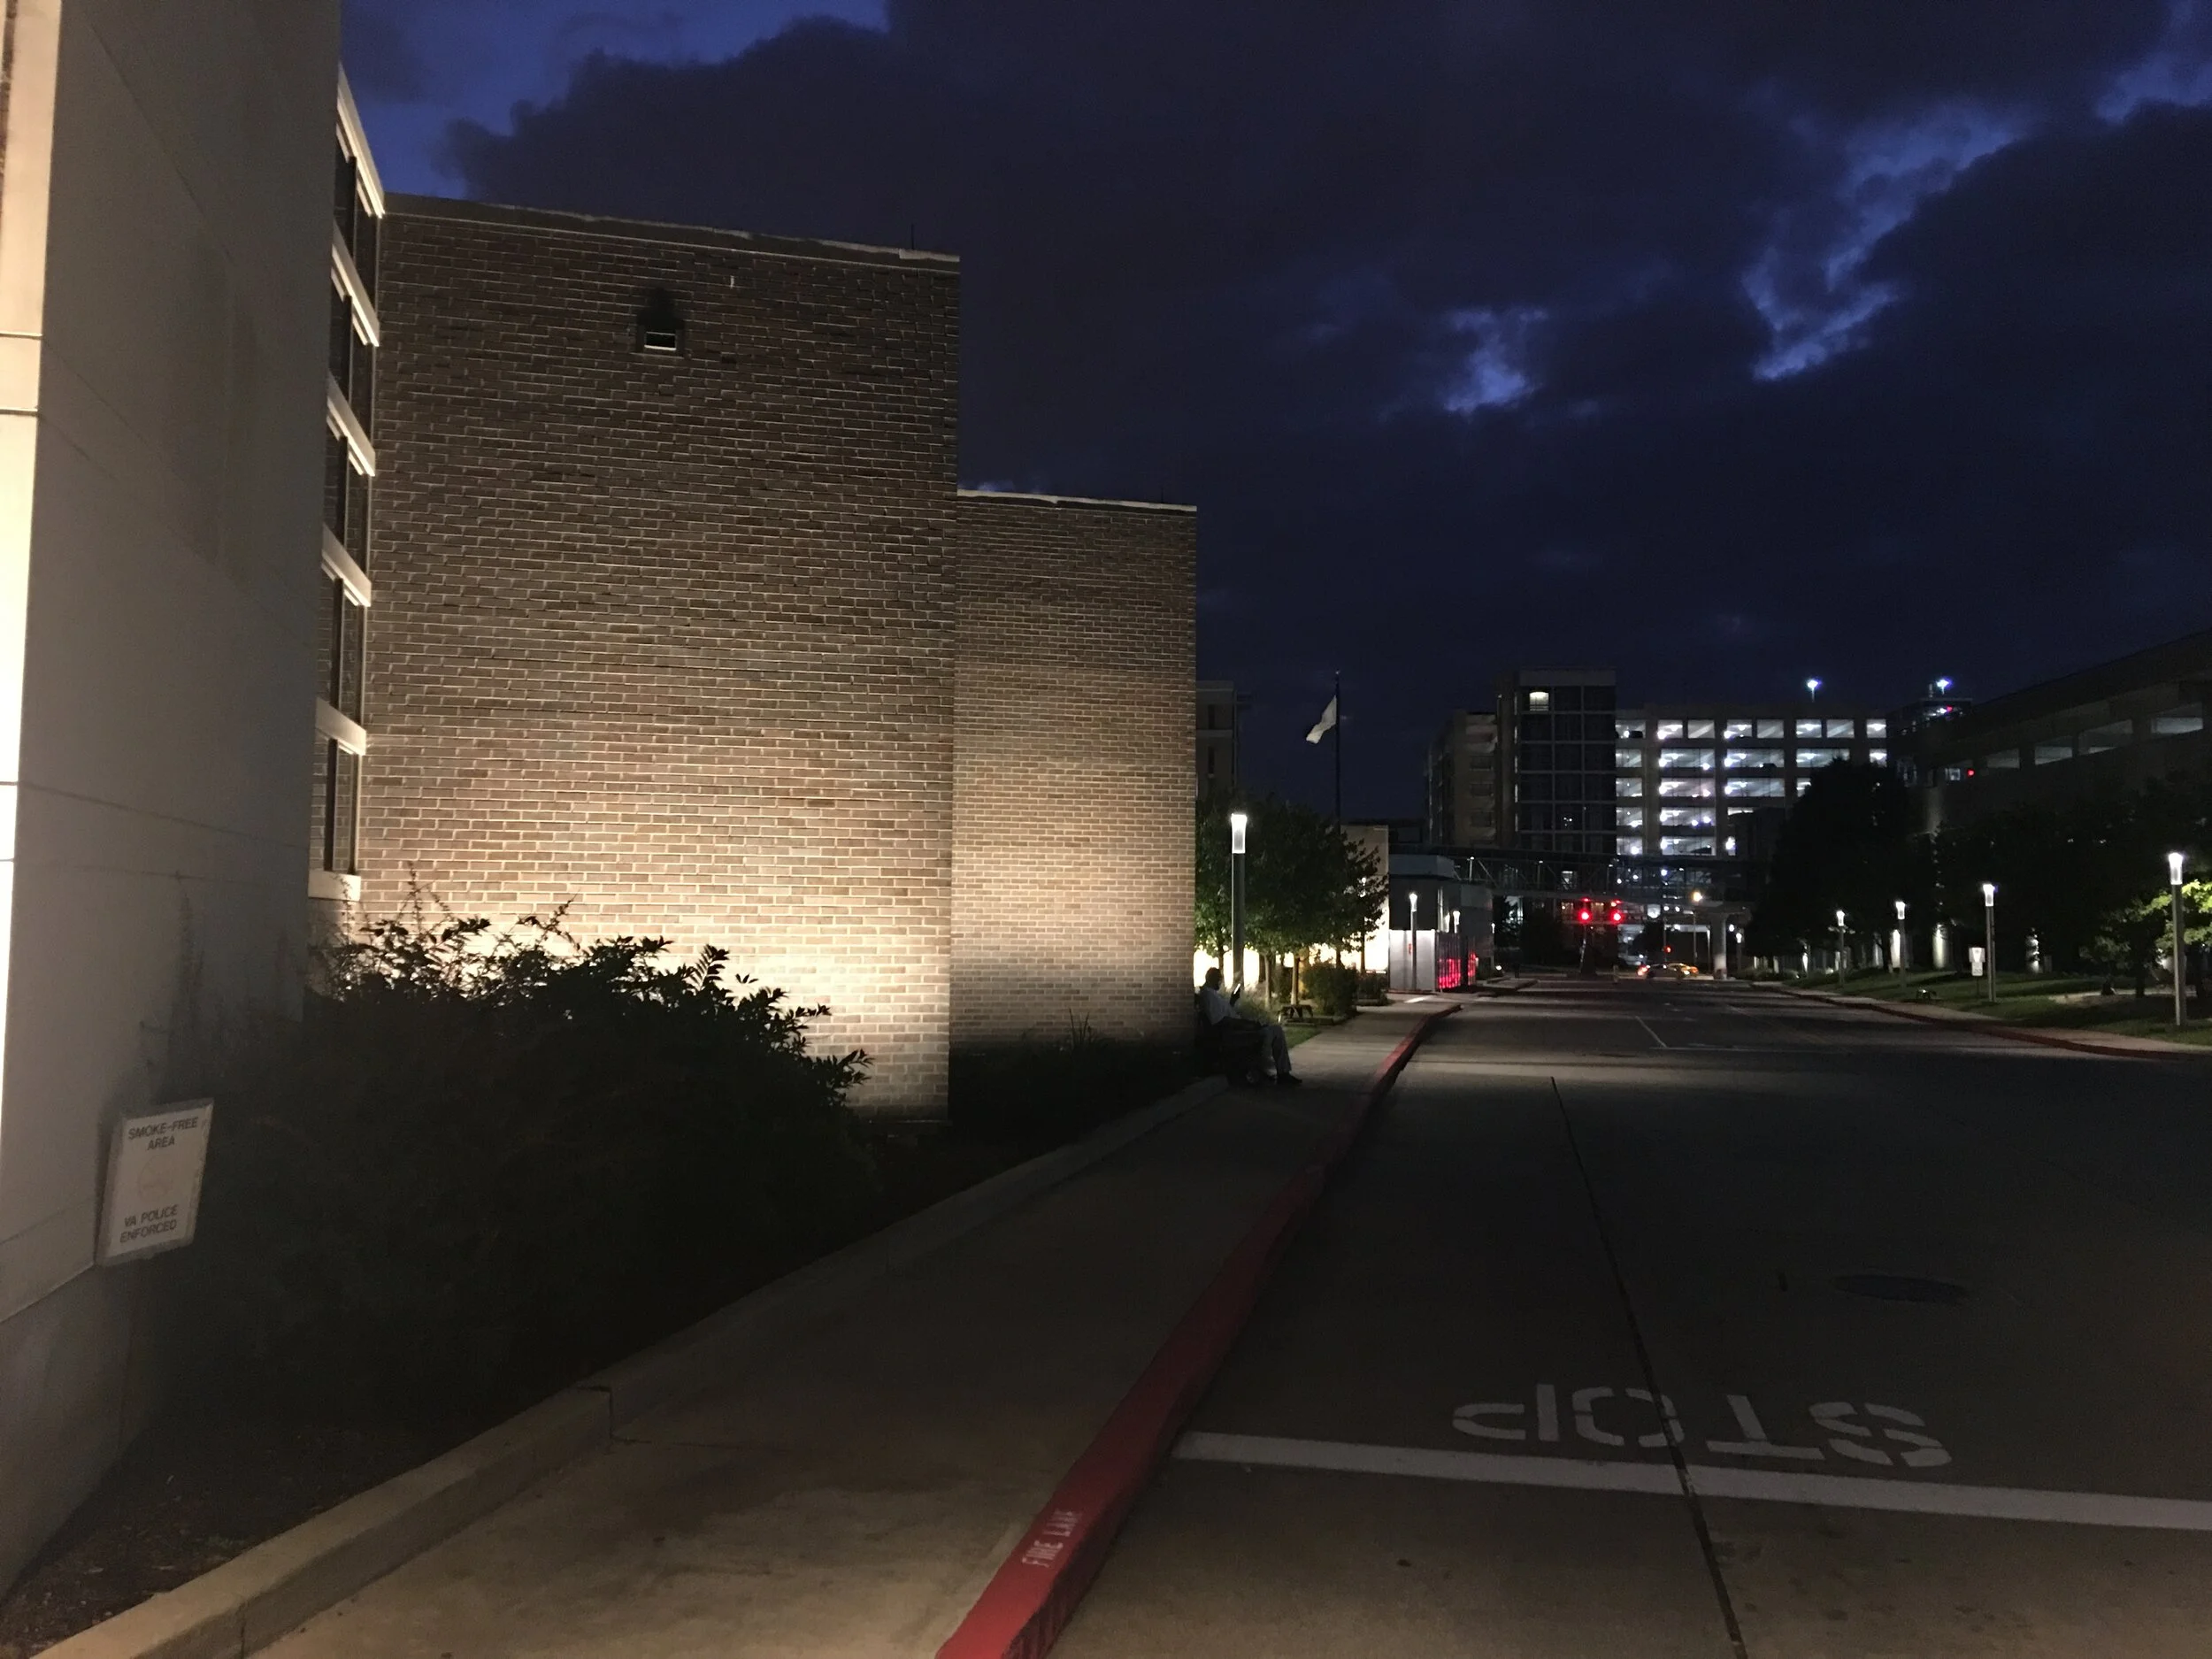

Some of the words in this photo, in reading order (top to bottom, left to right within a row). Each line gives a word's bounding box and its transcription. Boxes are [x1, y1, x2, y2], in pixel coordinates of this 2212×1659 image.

[128, 1118, 197, 1140] SMOKE-FREE
[147, 1136, 175, 1151] AREA
[125, 1216, 136, 1226] VA
[142, 1205, 178, 1222] POLICE
[120, 1220, 177, 1243] ENFORCED
[1452, 1383, 1952, 1468] STOP
